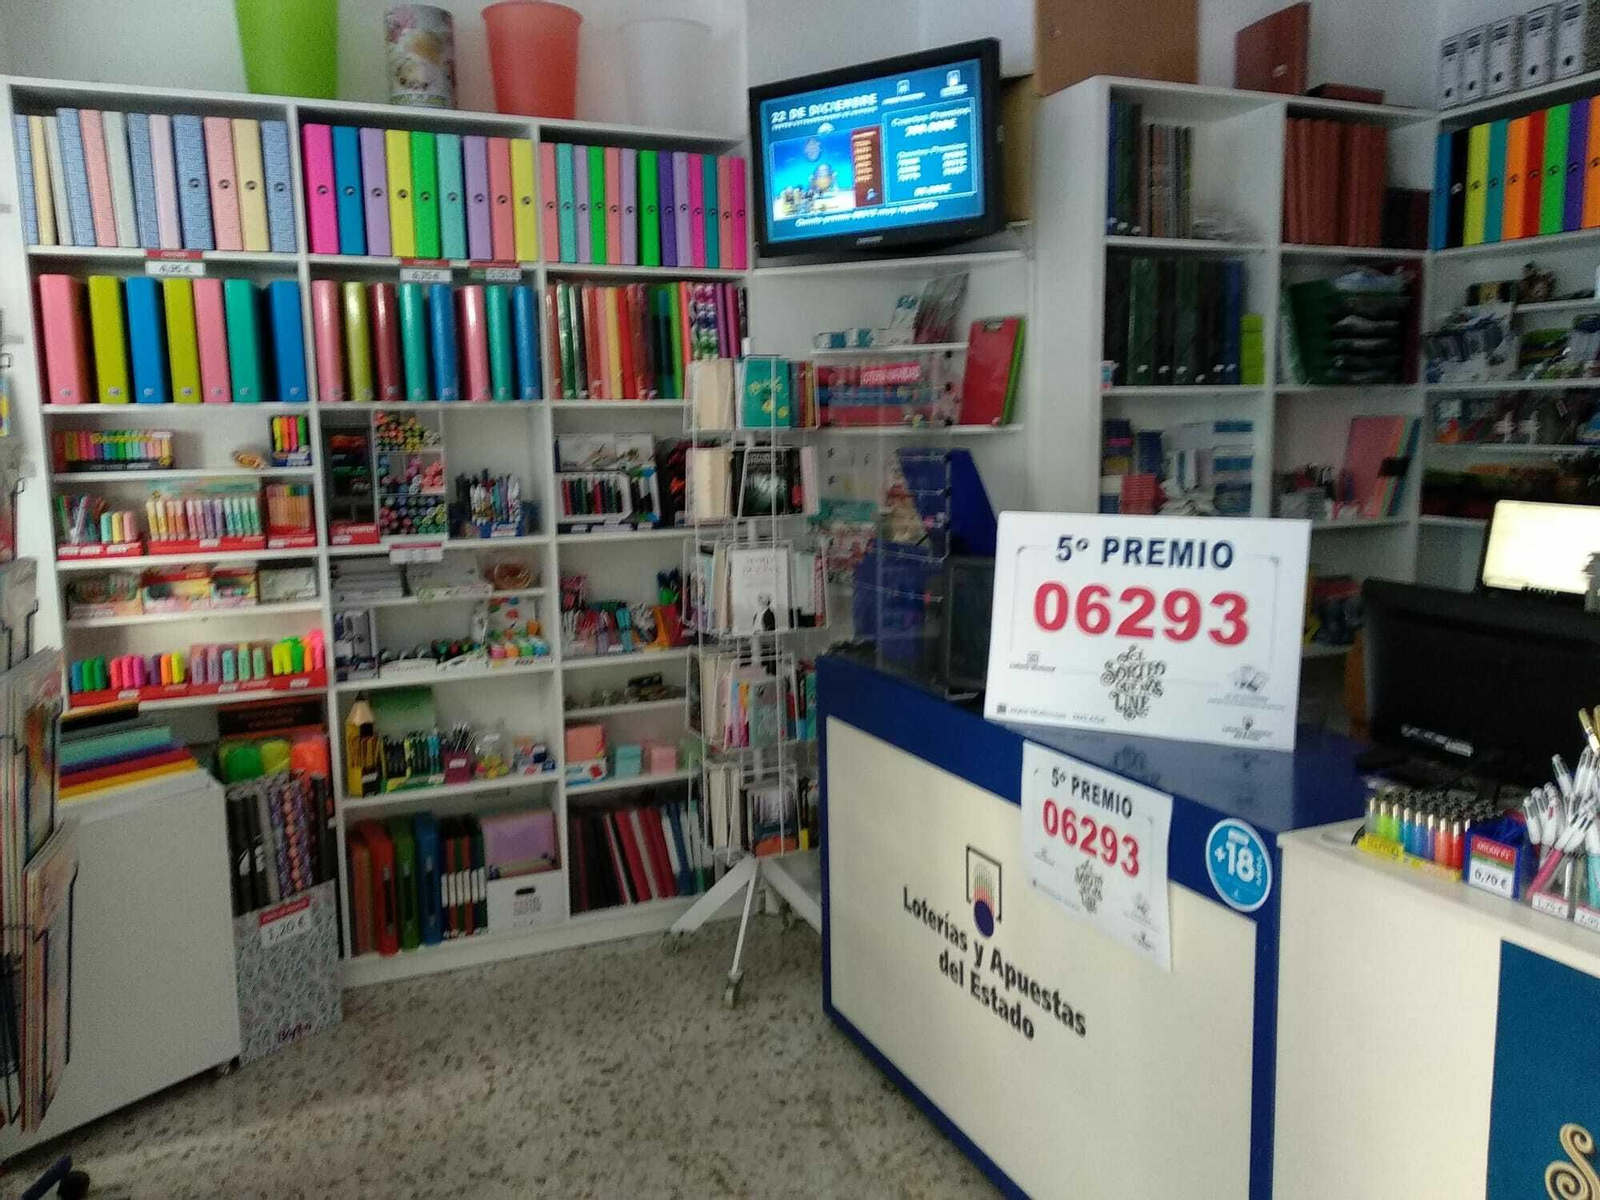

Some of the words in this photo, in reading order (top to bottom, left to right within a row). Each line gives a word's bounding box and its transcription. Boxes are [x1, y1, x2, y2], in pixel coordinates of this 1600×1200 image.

[771, 110, 787, 124] 22
[789, 106, 807, 121] DE
[1101, 536, 1235, 570] PREMIO
[1033, 580, 1249, 647] 06293
[1071, 776, 1133, 820] PREMIO
[1042, 798, 1140, 879] 06293
[1214, 840, 1255, 883] +18
[903, 883, 968, 953] Loterías
[973, 940, 984, 969] y
[990, 947, 1087, 1038] Apuestas
[939, 951, 964, 989] del
[970, 970, 1035, 1042] Estado
